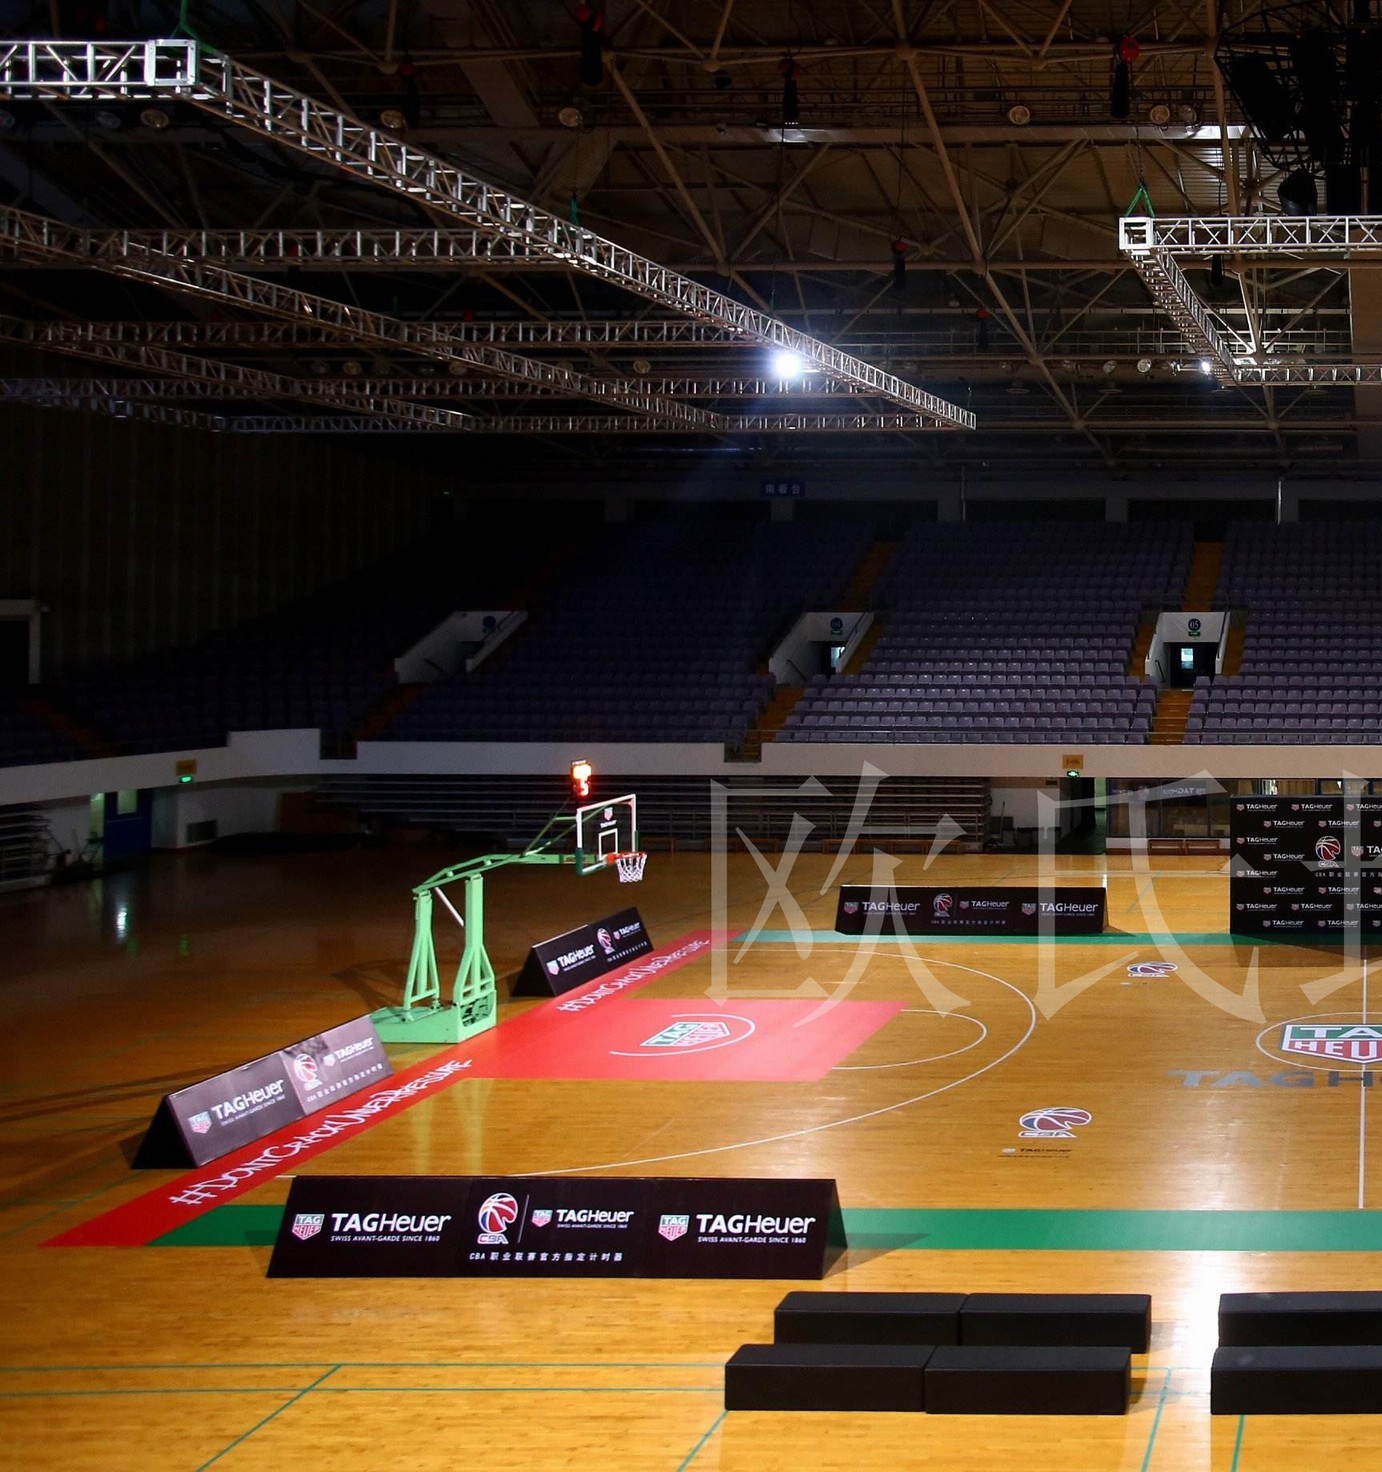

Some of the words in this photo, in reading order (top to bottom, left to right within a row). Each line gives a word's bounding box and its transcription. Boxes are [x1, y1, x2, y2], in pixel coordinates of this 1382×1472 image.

[1190, 619, 1199, 629] 05
[862, 901, 920, 911] TAGHeuer
[1040, 902, 1098, 912] TAGHeuer
[558, 944, 595, 967] TAGHeuer
[210, 1079, 284, 1119] TAGHeuer
[298, 1215, 321, 1224] TAG
[331, 1213, 451, 1232] TAGHeuer
[556, 1209, 634, 1223] TAGHeuer
[662, 1216, 687, 1225] TAG
[696, 1214, 816, 1233] TAGHeuer
[294, 1224, 322, 1238] HEUER
[660, 1225, 687, 1238] HEUER
